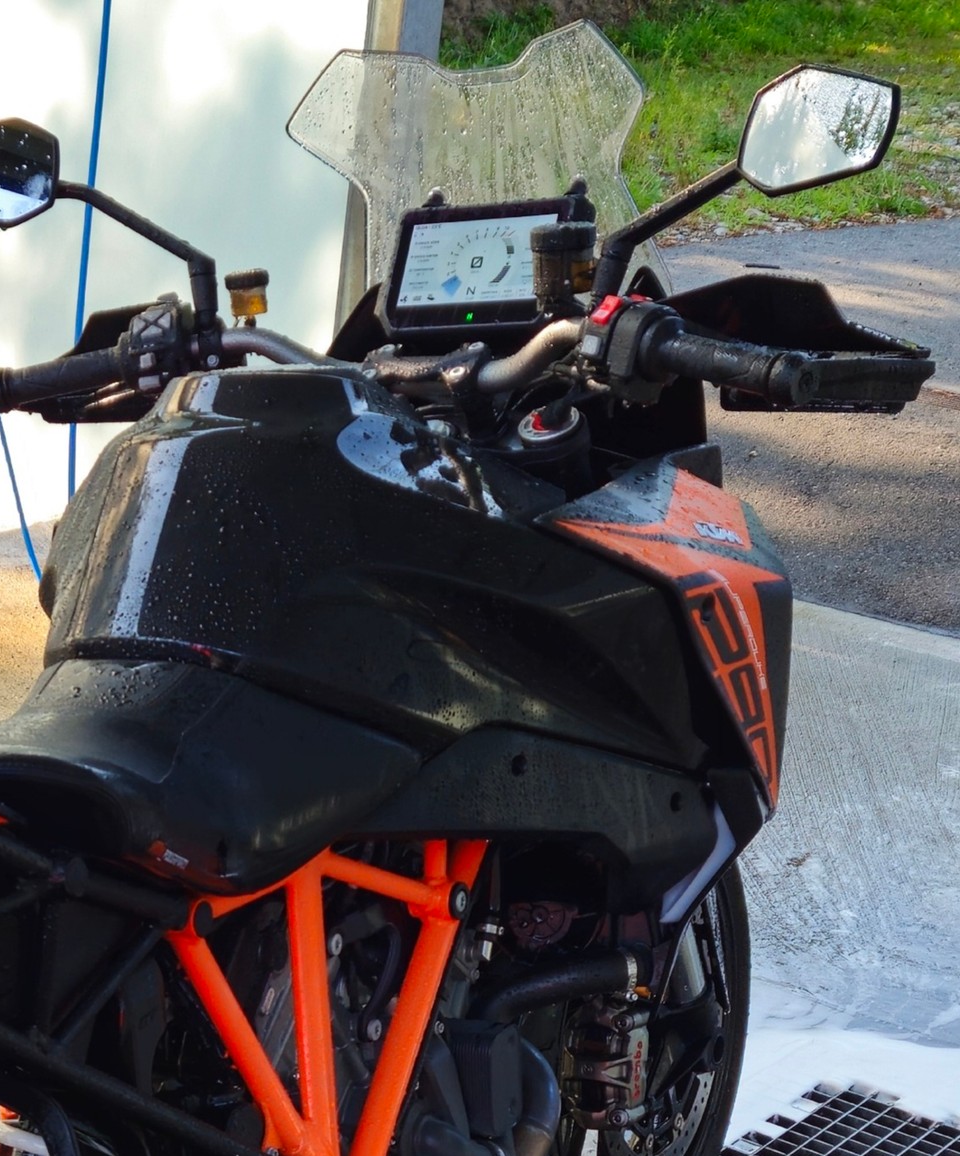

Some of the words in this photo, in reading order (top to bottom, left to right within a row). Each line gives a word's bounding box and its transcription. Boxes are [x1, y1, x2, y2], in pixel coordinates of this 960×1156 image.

[466, 286, 476, 296] N
[693, 521, 744, 546] KTM
[633, 1041, 643, 1099] brembo
